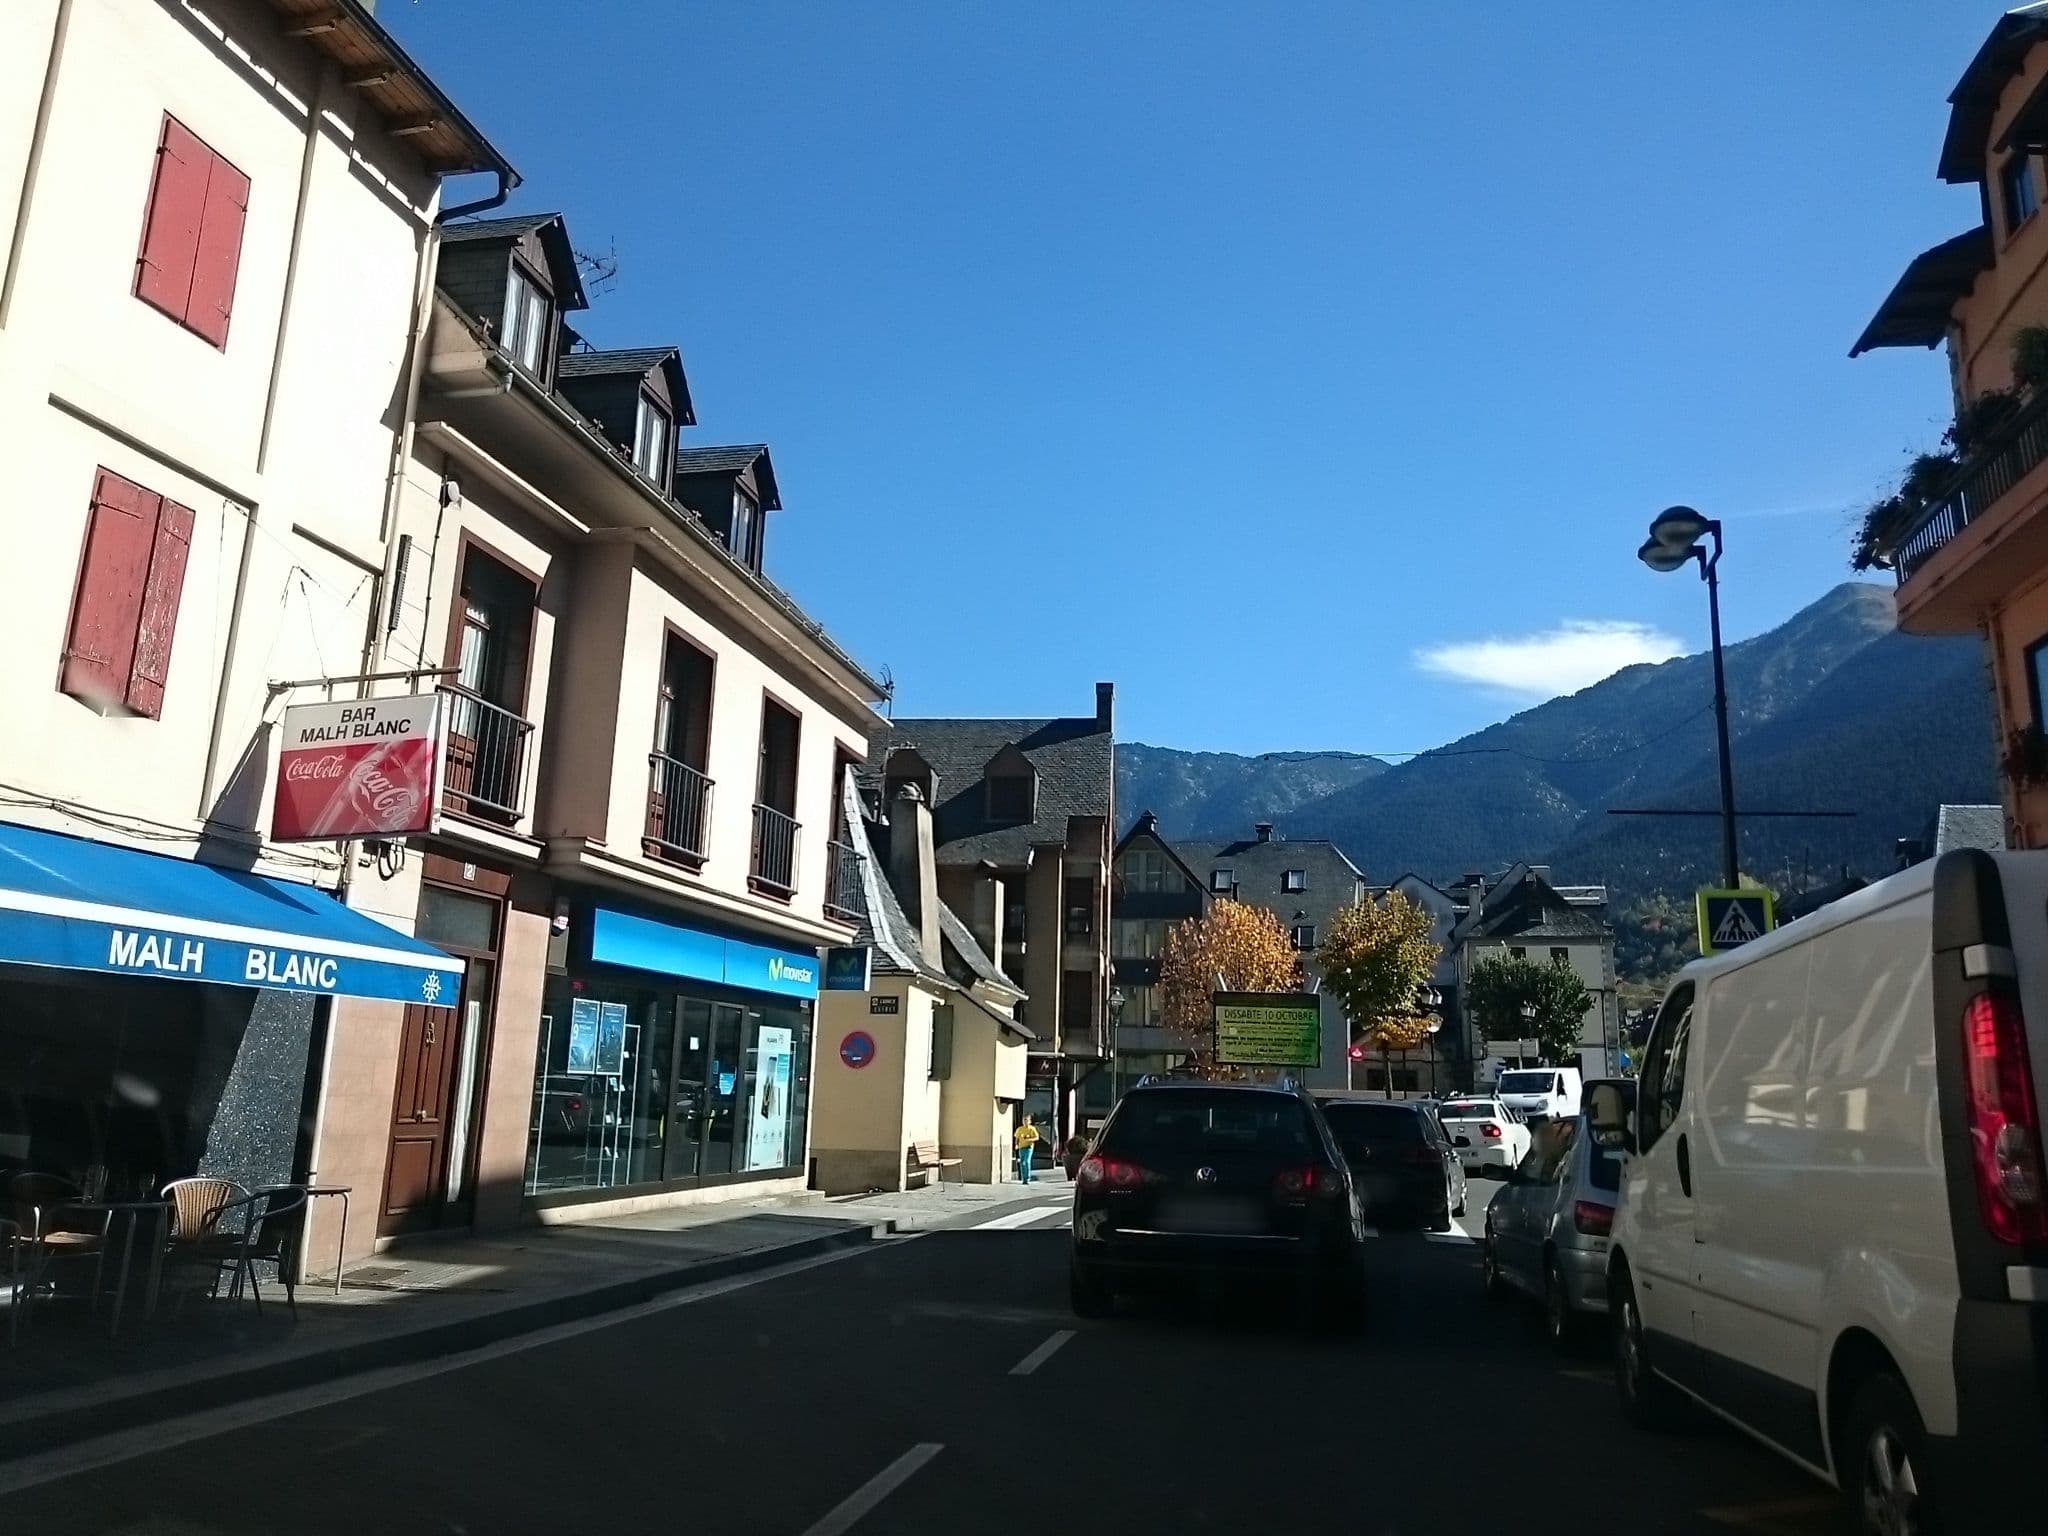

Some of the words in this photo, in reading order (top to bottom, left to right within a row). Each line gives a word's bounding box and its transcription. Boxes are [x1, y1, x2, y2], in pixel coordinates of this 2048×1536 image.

[341, 706, 376, 723] BAR
[300, 725, 348, 743] MALH
[352, 719, 411, 738] BLANC
[466, 864, 473, 878] 2
[108, 930, 205, 973] MALH
[245, 948, 338, 988] BLANC
[783, 966, 813, 984] movistar
[1224, 1009, 1261, 1020] DISSABTE
[1265, 1010, 1274, 1020] 10
[1275, 1010, 1313, 1021] OCTOBRE
